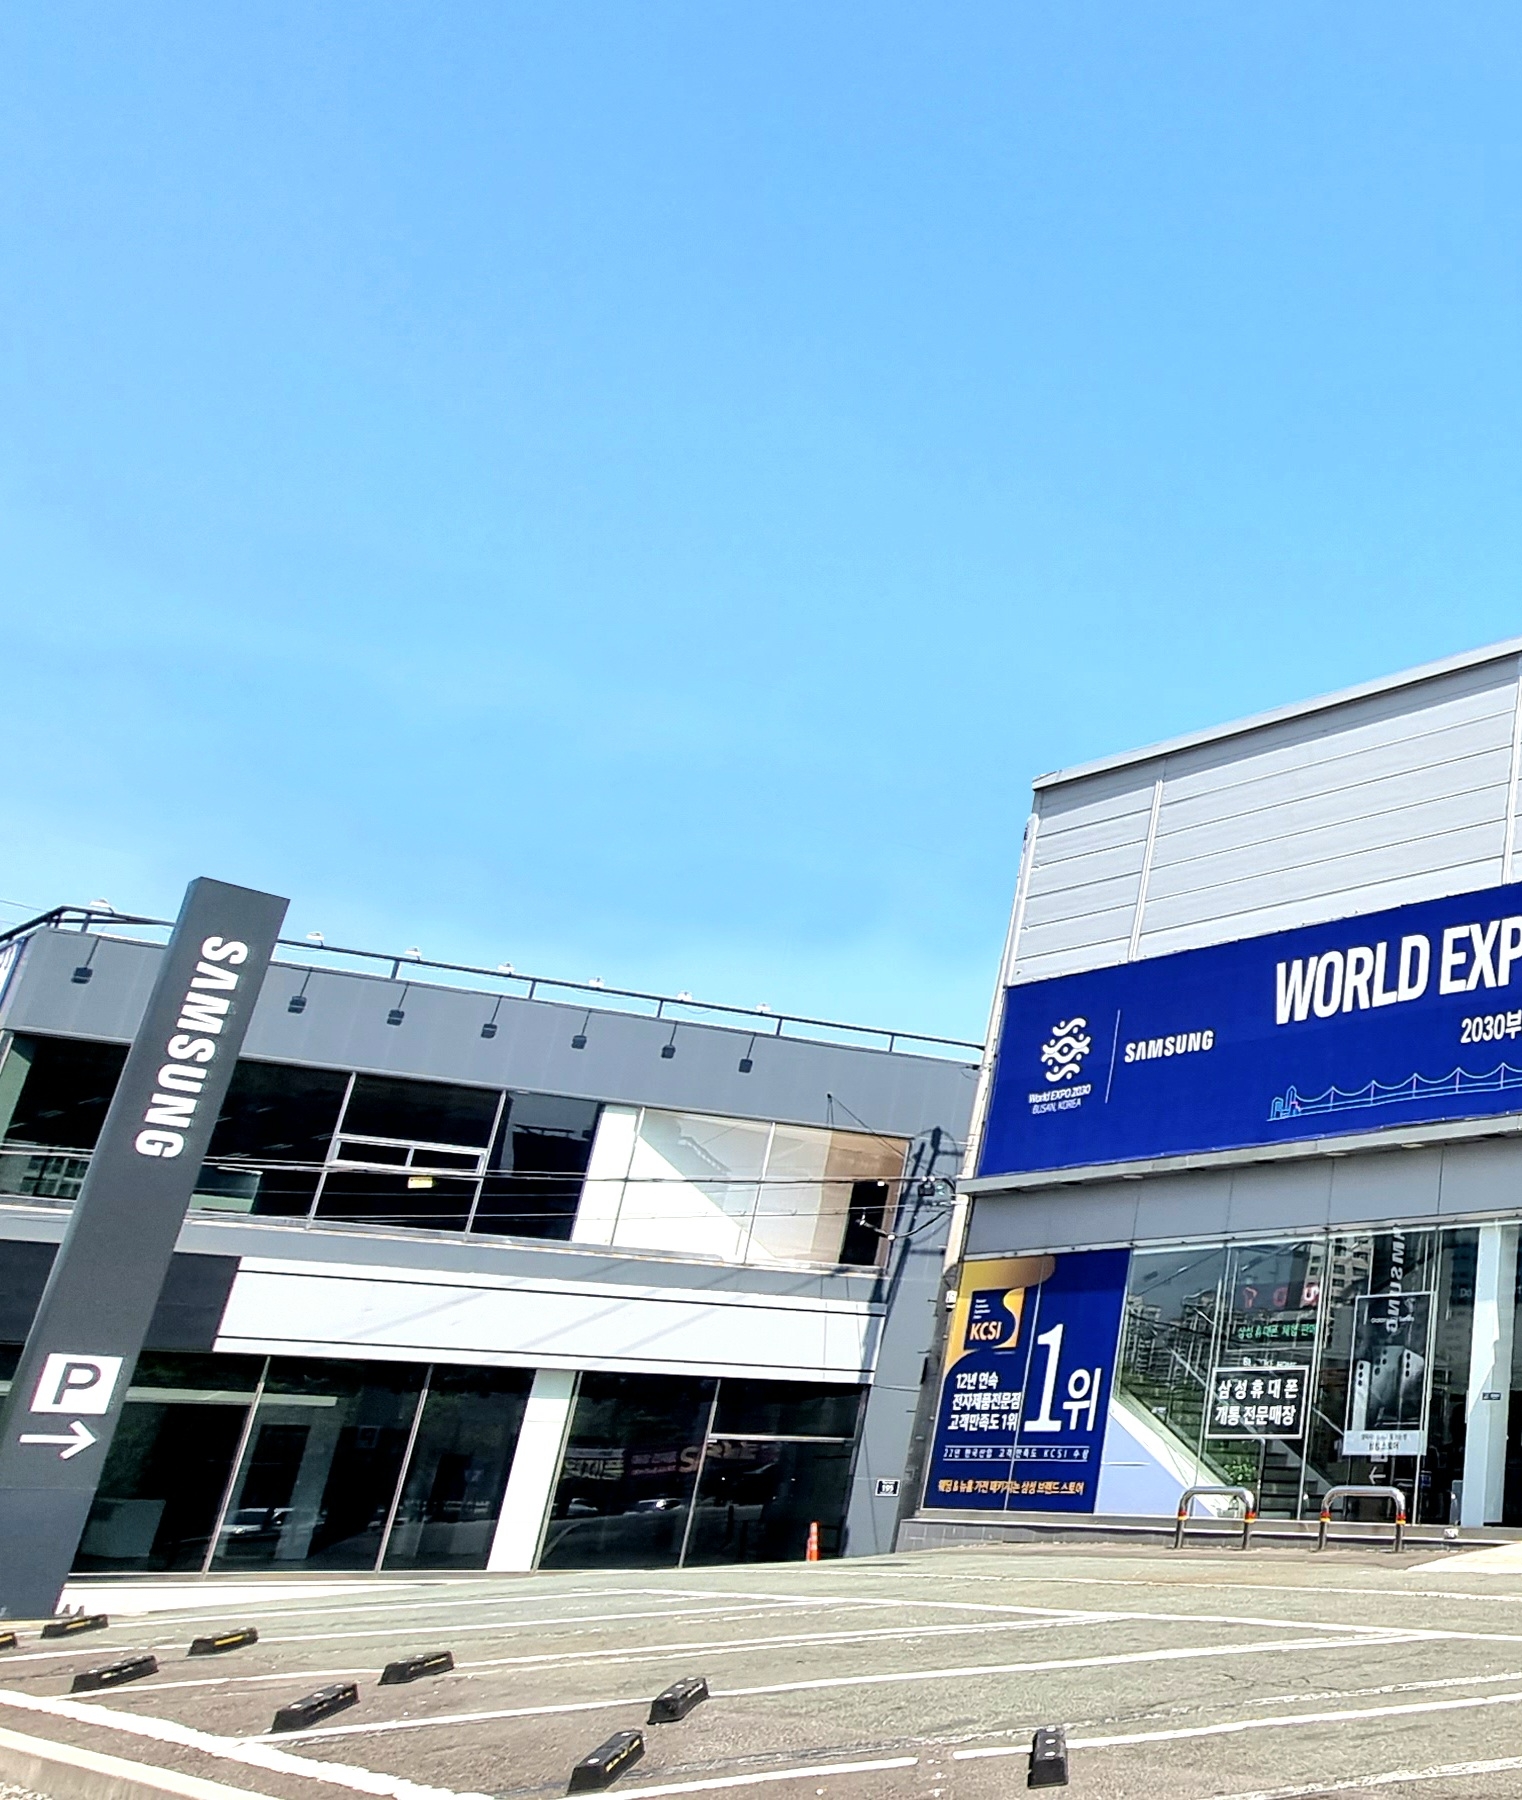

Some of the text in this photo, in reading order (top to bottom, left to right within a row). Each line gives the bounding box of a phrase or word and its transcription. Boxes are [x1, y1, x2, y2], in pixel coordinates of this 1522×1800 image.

[1275, 935, 1429, 1025] WORLD
[134, 935, 249, 1159] SAMSUNG
[1124, 1030, 1214, 1063] SAMSUNG
[970, 1321, 1002, 1341] KCSI
[53, 1362, 101, 1405] P
[956, 1371, 999, 1390] 12년 연속
[1024, 1323, 1102, 1432] 1위
[947, 1412, 1018, 1432] 고객만족도 1위
[1215, 1405, 1241, 1426] 개통
